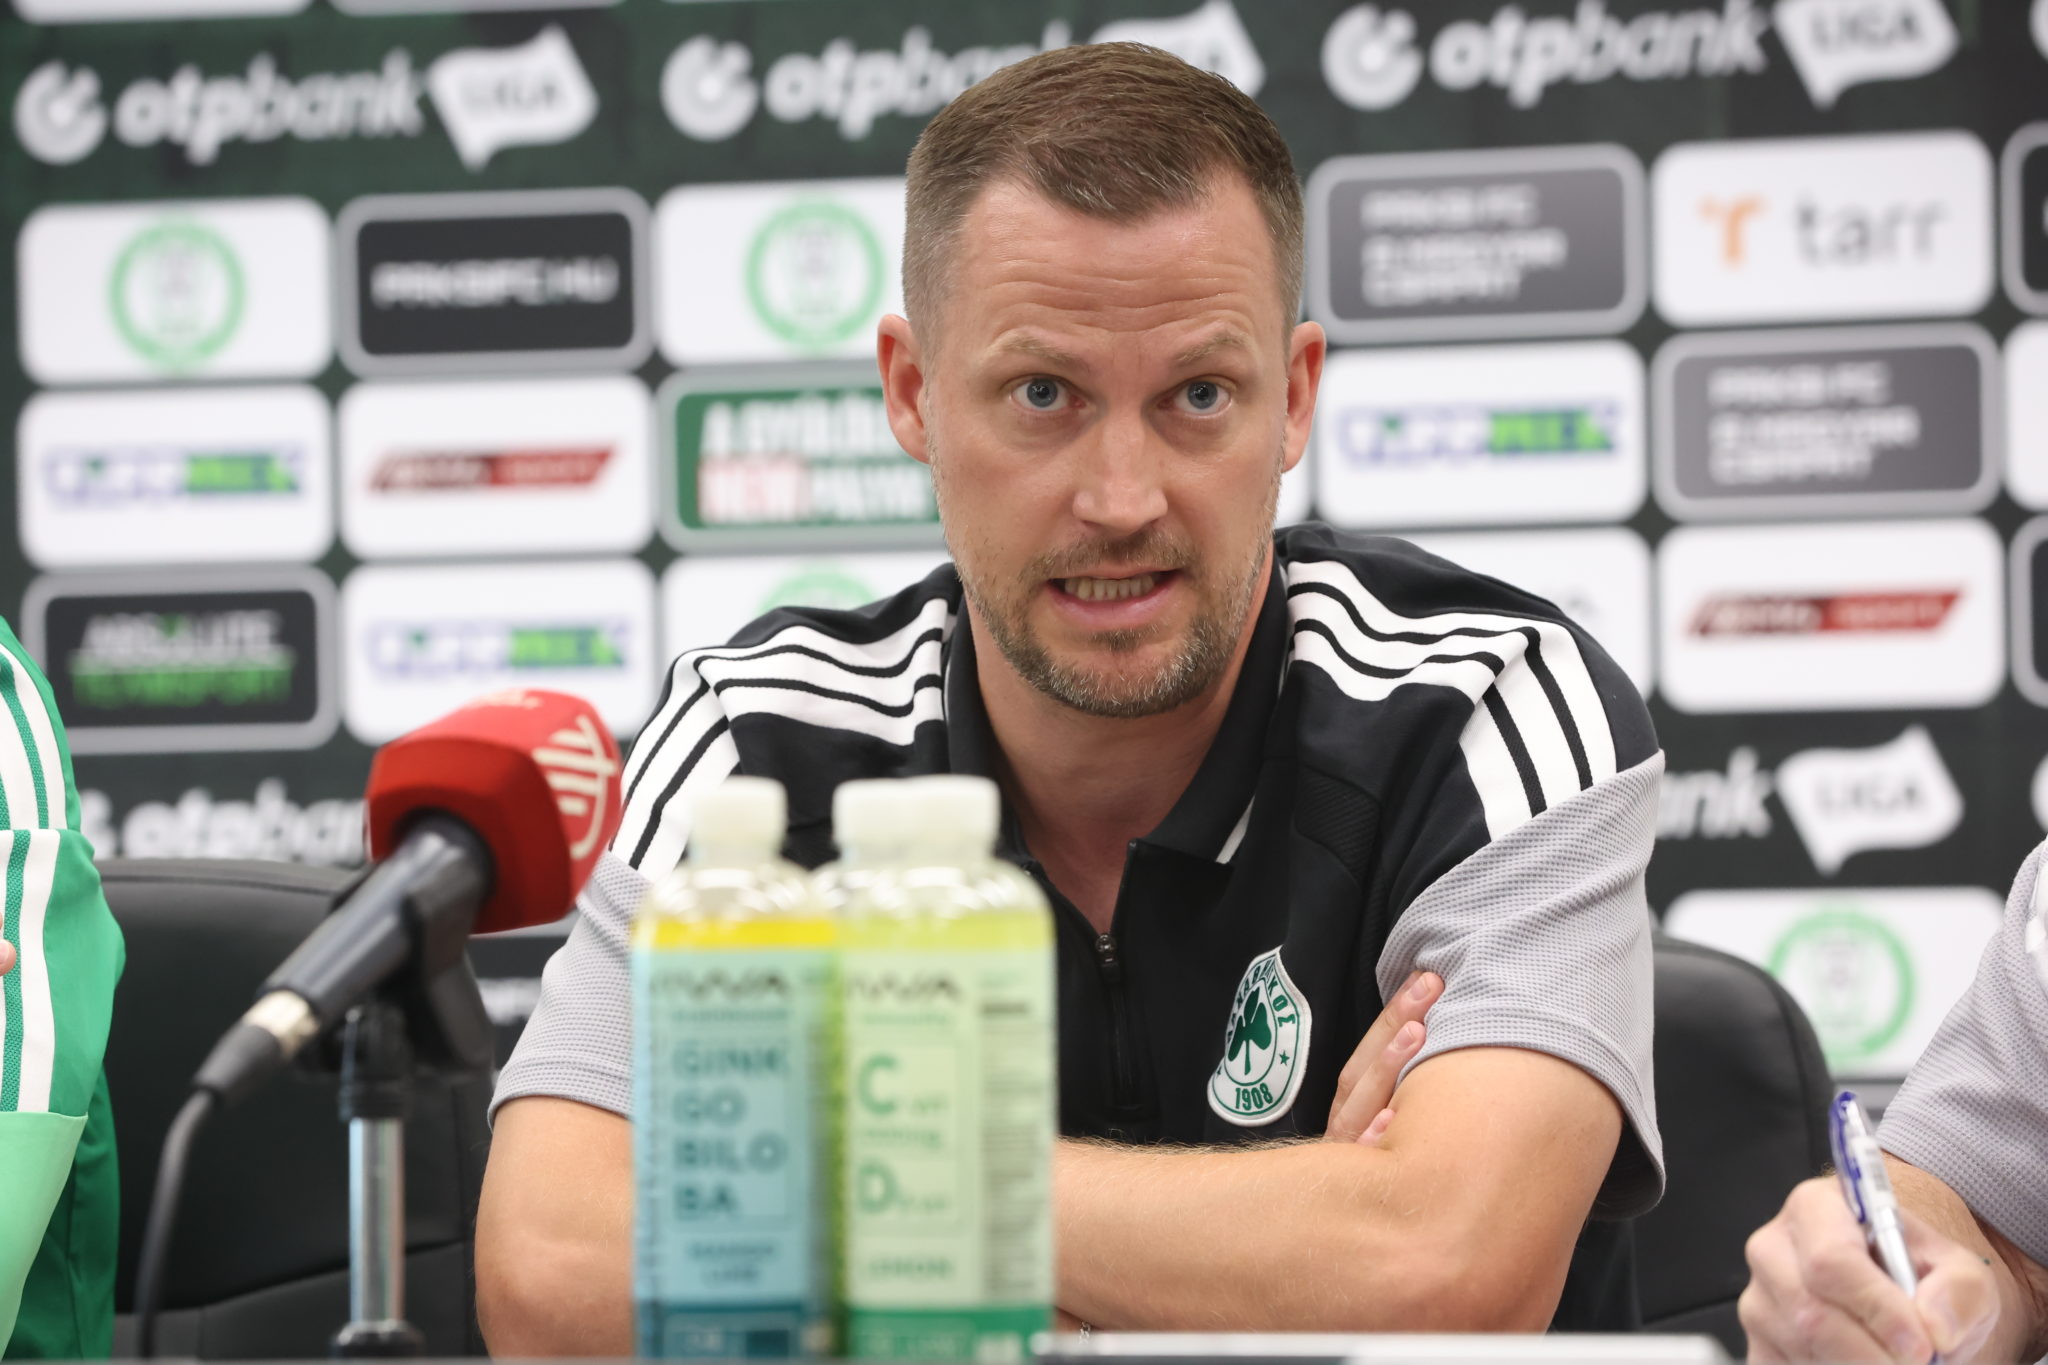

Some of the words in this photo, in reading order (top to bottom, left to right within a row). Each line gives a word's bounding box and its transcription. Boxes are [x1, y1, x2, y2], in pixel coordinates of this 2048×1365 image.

[764, 20, 1072, 141] otpba
[1430, 0, 1768, 108] otpbank
[1811, 4, 1924, 54] LIGA
[112, 47, 424, 165] otpbank
[1798, 196, 1946, 268] tarr
[124, 778, 367, 862] otpba
[676, 1089, 747, 1126] GO
[857, 1053, 902, 1117] C
[1234, 1083, 1274, 1111] 1908
[677, 1134, 787, 1172] BILO
[677, 1182, 740, 1218] BA
